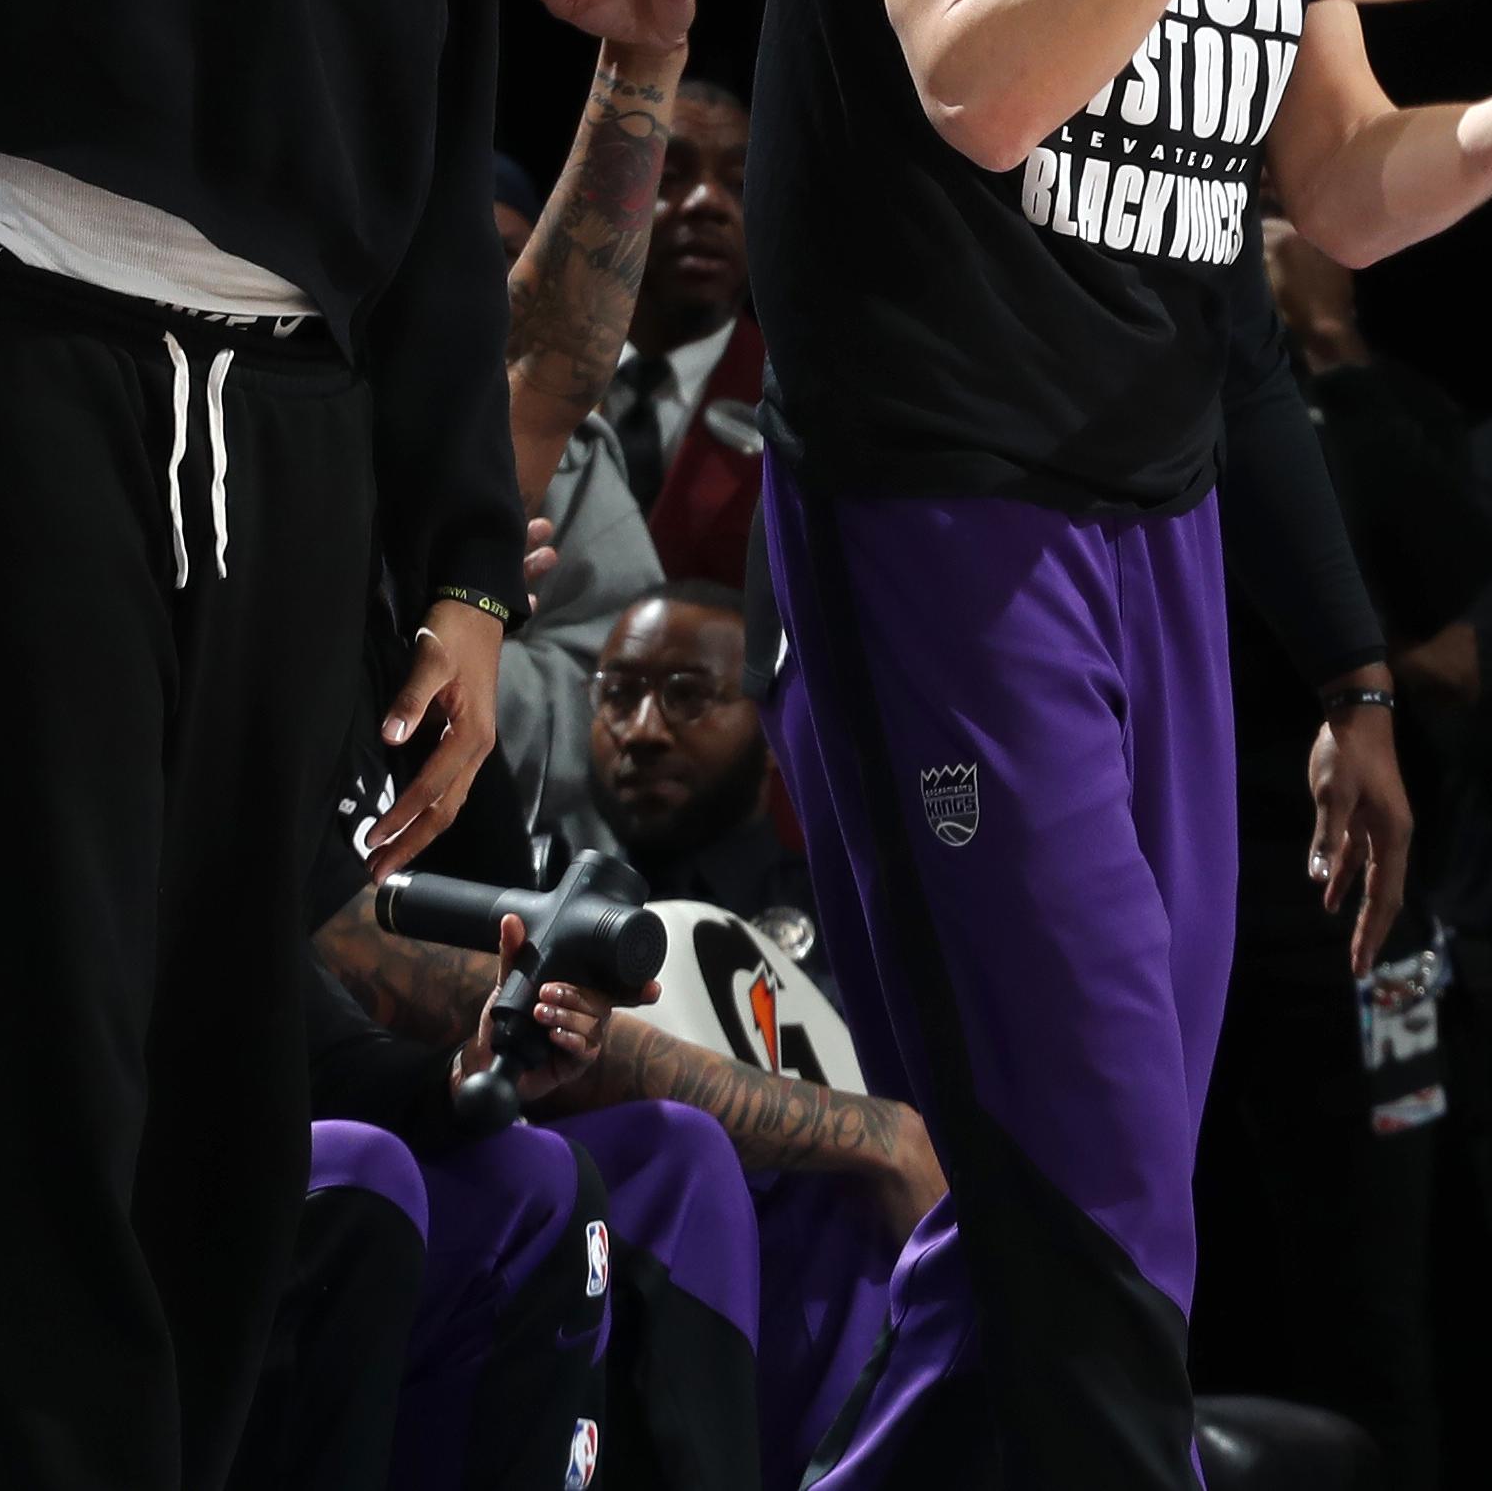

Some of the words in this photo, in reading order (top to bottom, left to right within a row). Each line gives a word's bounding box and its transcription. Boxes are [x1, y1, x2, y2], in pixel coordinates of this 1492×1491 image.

[1086, 19, 1299, 146] STORY
[1022, 147, 1175, 257] BLACK
[1061, 126, 1213, 169] LEVATED
